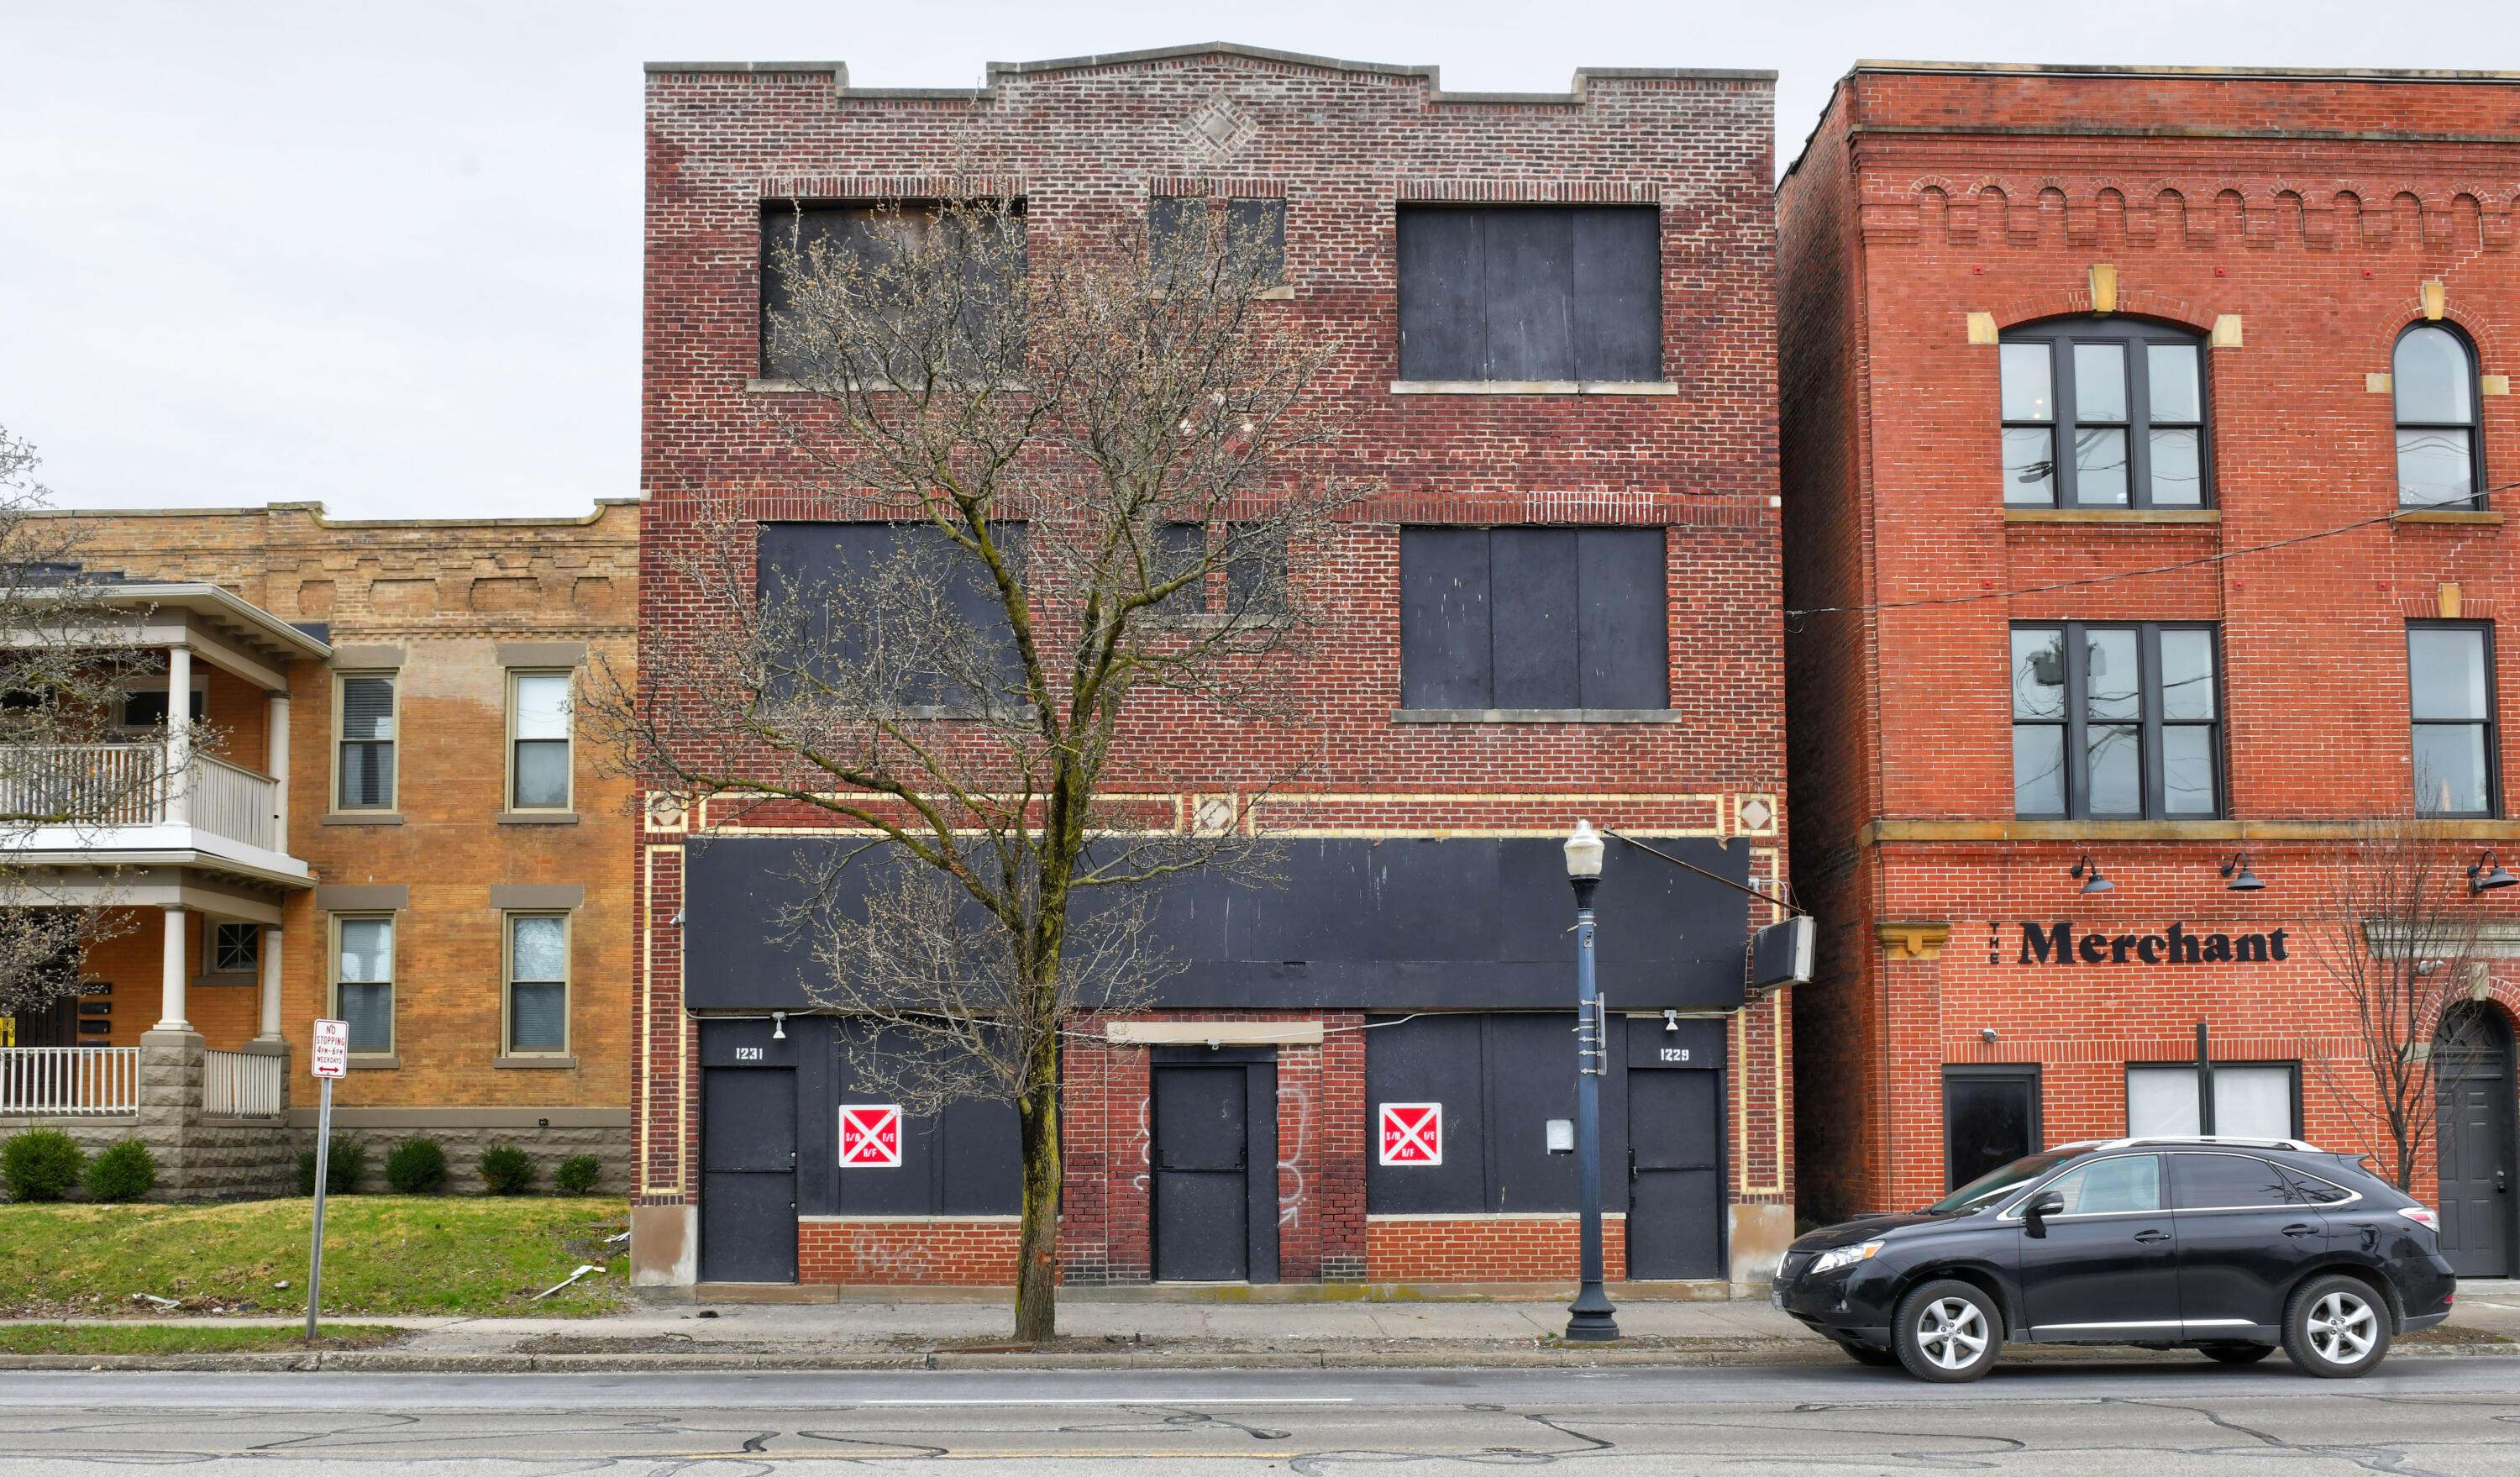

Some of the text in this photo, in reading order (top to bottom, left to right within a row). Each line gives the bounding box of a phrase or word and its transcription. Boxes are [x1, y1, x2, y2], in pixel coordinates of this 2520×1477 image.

[1989, 921, 2289, 965] THE Merchant
[326, 1025, 336, 1034] NO
[317, 1035, 345, 1045] STOPPING
[317, 1046, 343, 1055] 4PM-6PM
[736, 1047, 763, 1059] 1231
[1661, 1048, 1689, 1061] 1229
[882, 1133, 895, 1142] F/E
[1423, 1131, 1435, 1140] F/E
[1401, 1148, 1415, 1157] H/F
